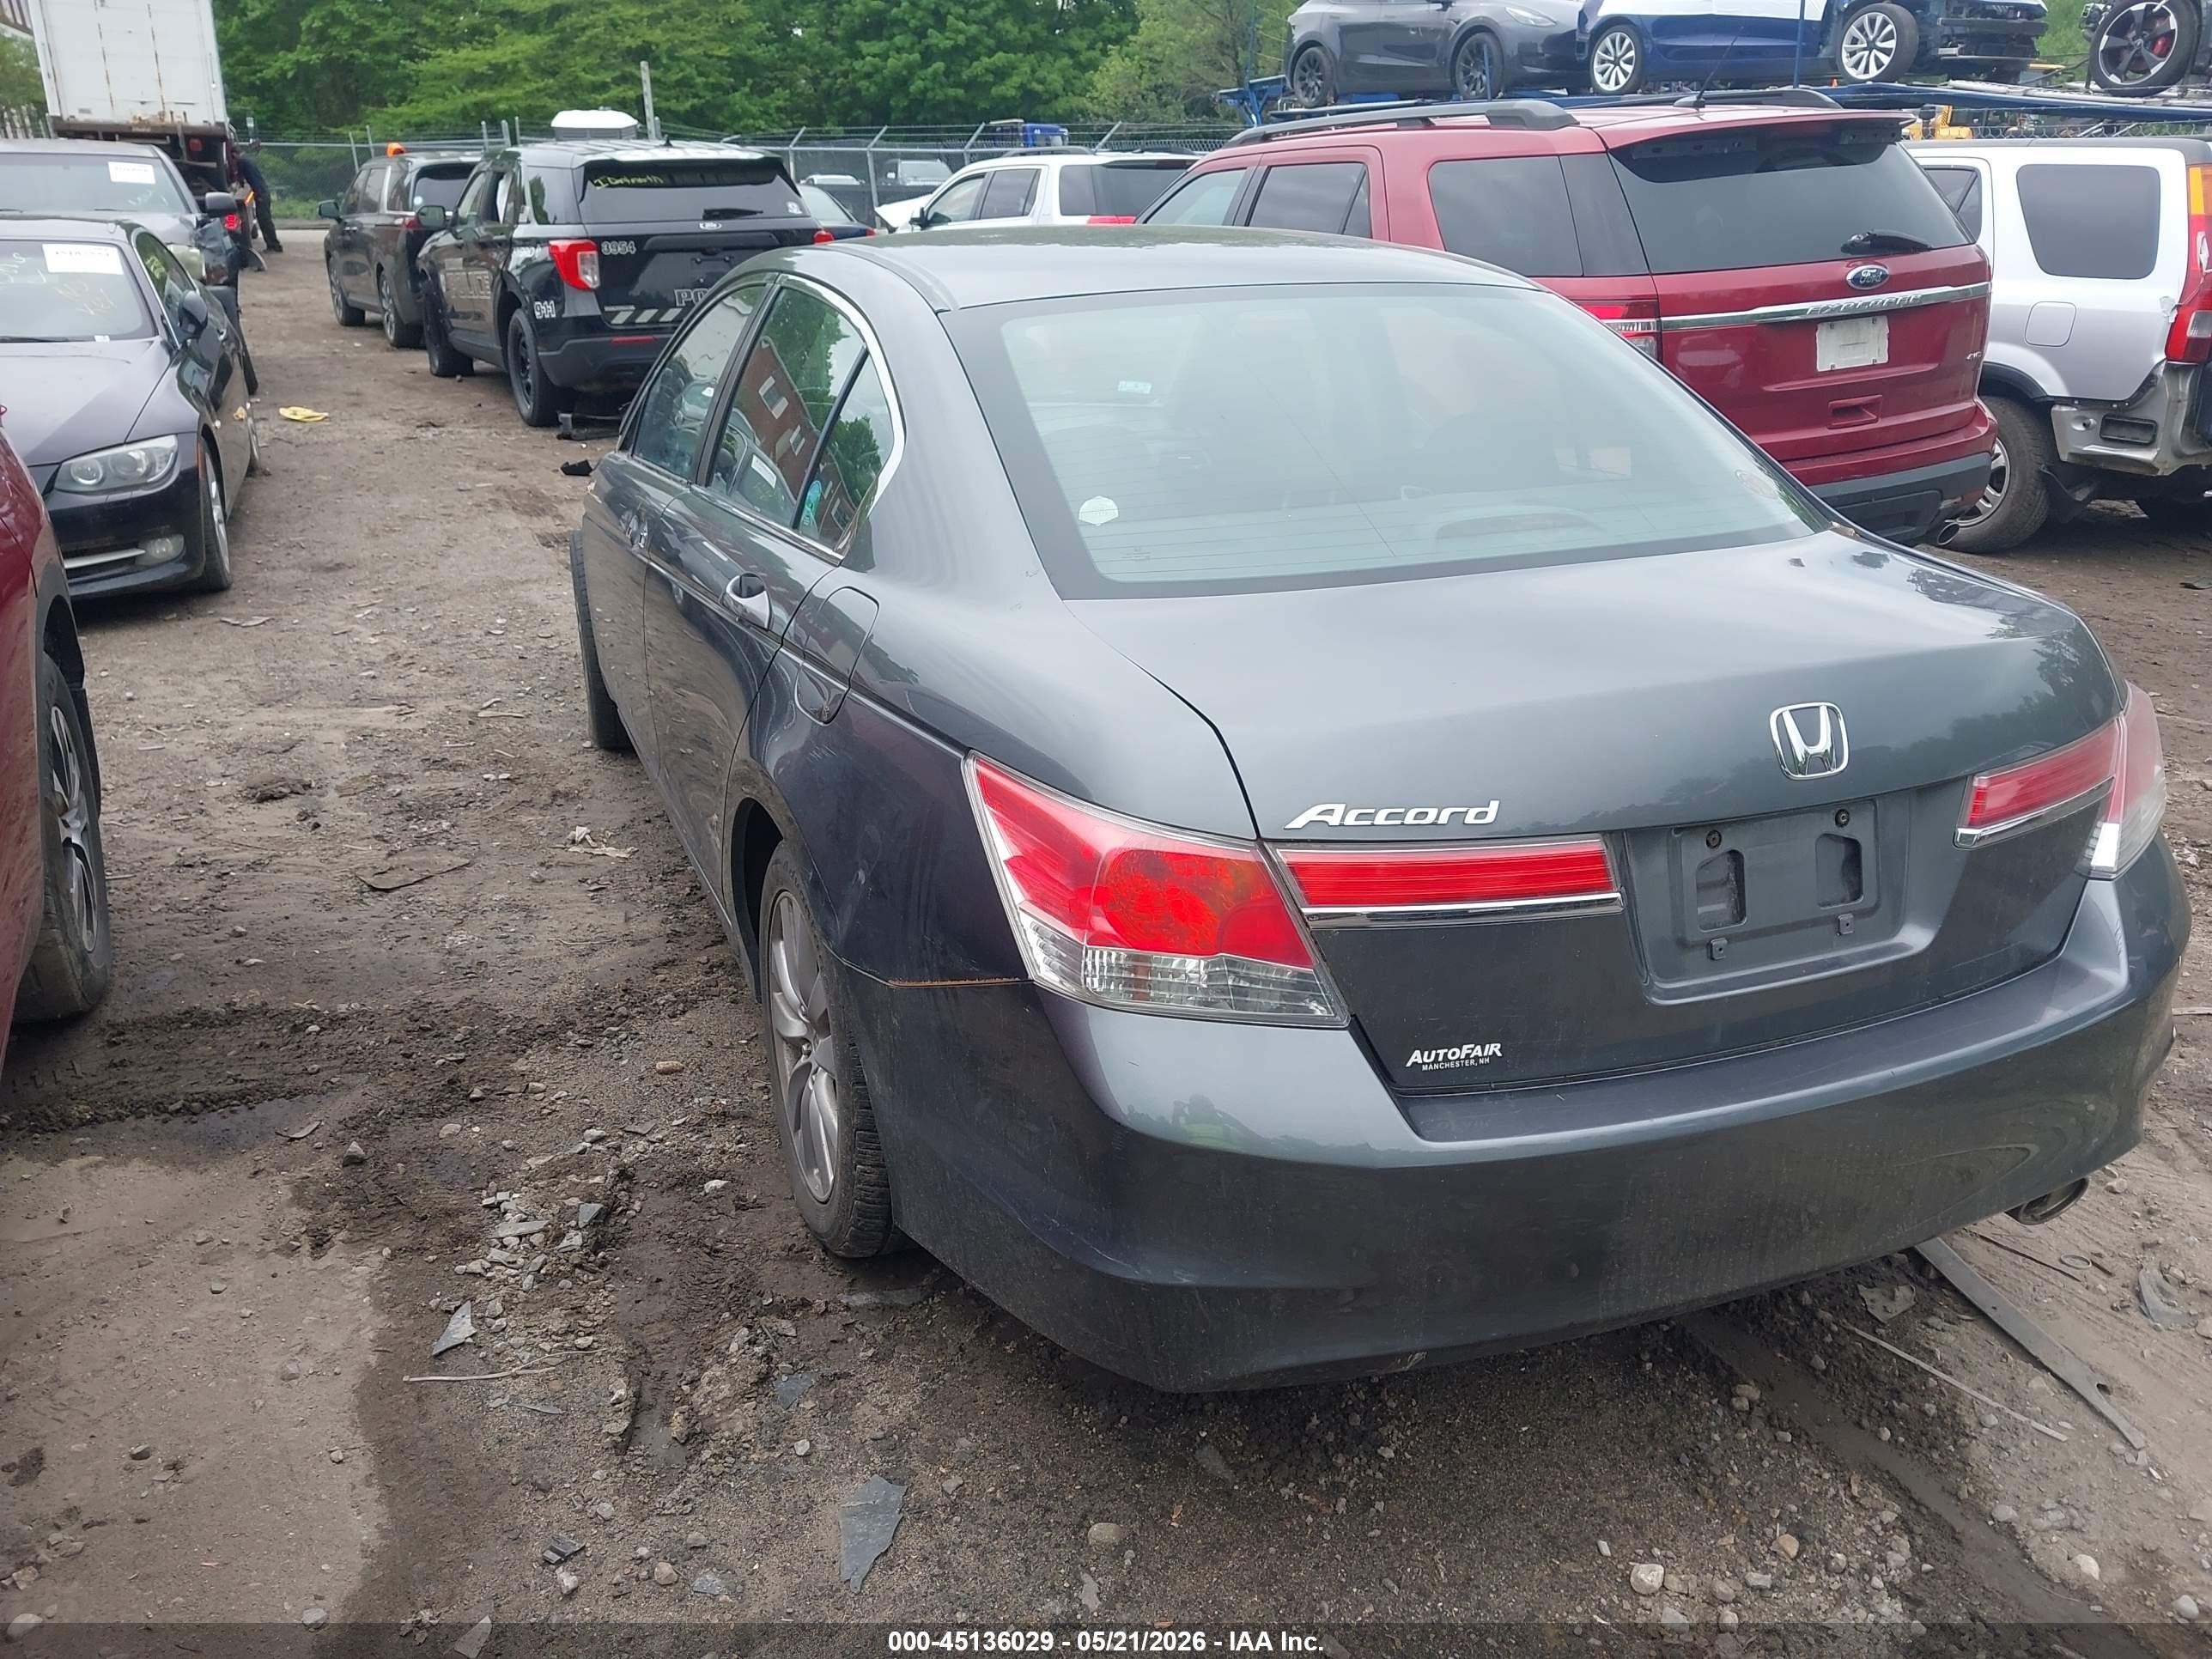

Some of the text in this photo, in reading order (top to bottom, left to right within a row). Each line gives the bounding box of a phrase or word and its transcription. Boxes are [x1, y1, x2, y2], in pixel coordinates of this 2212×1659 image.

[1807, 294, 1922, 315] EXPLORER
[1283, 799, 1500, 830] Accord
[1421, 1056, 1490, 1072] MANCHESTER, NH
